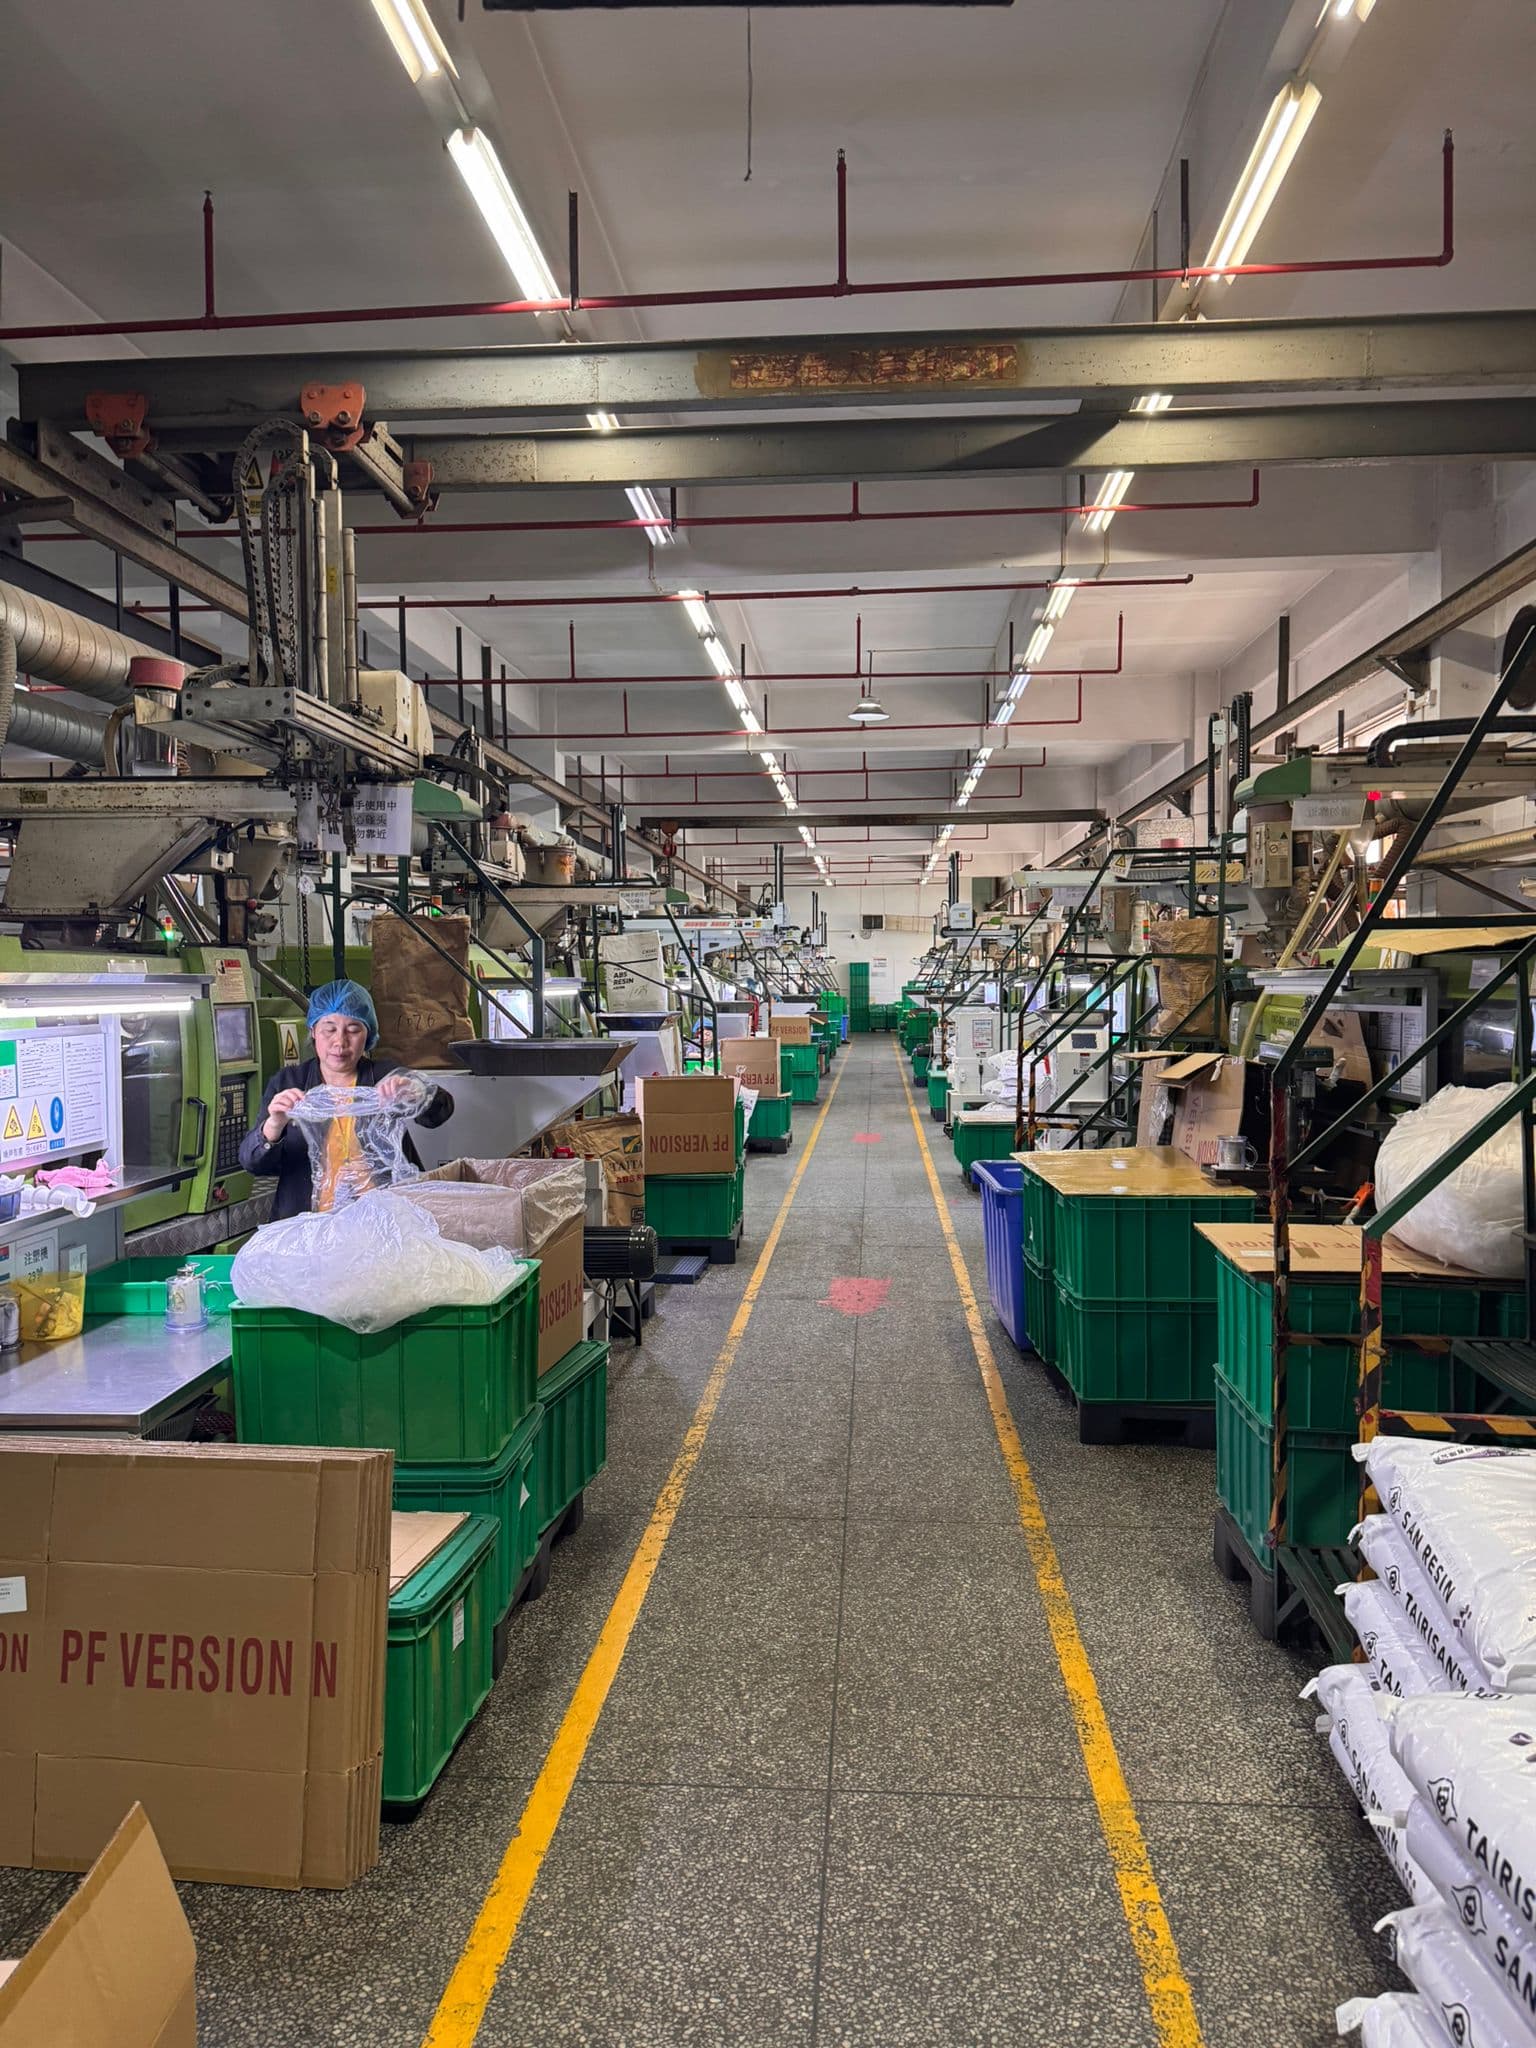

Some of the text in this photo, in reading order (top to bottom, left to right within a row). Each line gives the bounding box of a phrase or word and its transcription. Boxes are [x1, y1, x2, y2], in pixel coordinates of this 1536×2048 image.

[355, 800, 397, 811] 手使用中
[356, 828, 387, 840] 勿靠近
[779, 1025, 807, 1035] VERSION
[740, 1073, 775, 1085] PF VERS
[649, 1134, 729, 1153] PF VERSION
[539, 1280, 573, 1334] VERSIO
[1402, 1511, 1456, 1603] SAN RESIN
[60, 1629, 293, 1696] PF VERSION
